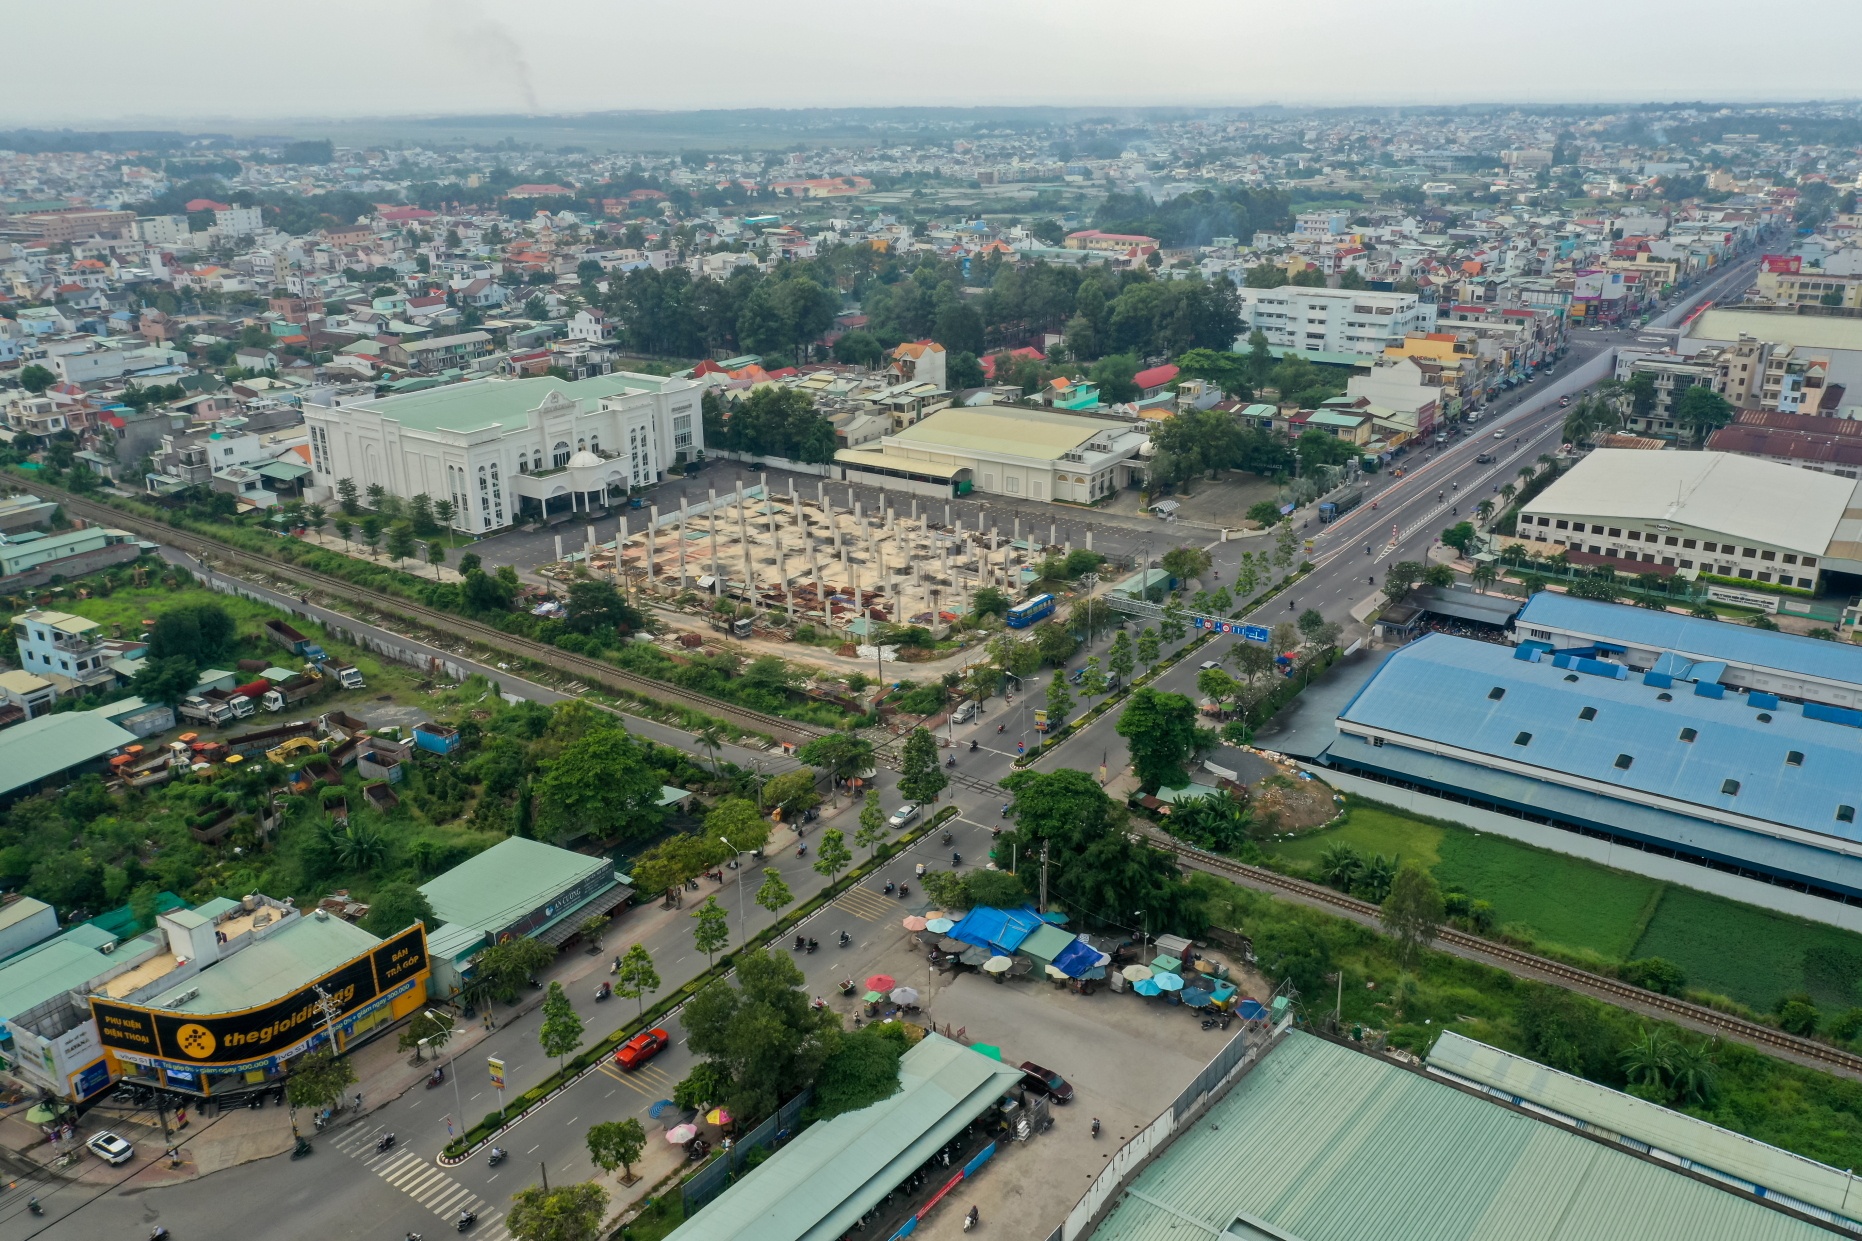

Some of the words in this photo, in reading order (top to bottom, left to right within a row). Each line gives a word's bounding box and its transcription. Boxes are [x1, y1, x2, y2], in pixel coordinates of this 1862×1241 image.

[391, 947, 409, 962] BÁN
[402, 955, 419, 969] GÓP
[387, 983, 410, 999] 300.000
[105, 1015, 121, 1027] PHỤ
[123, 1019, 142, 1031] KIỆN
[104, 1027, 123, 1040] ĐIỆN
[124, 1032, 150, 1045] THOẠI
[120, 1054, 138, 1062] vivo
[237, 1060, 269, 1072] 300.000
